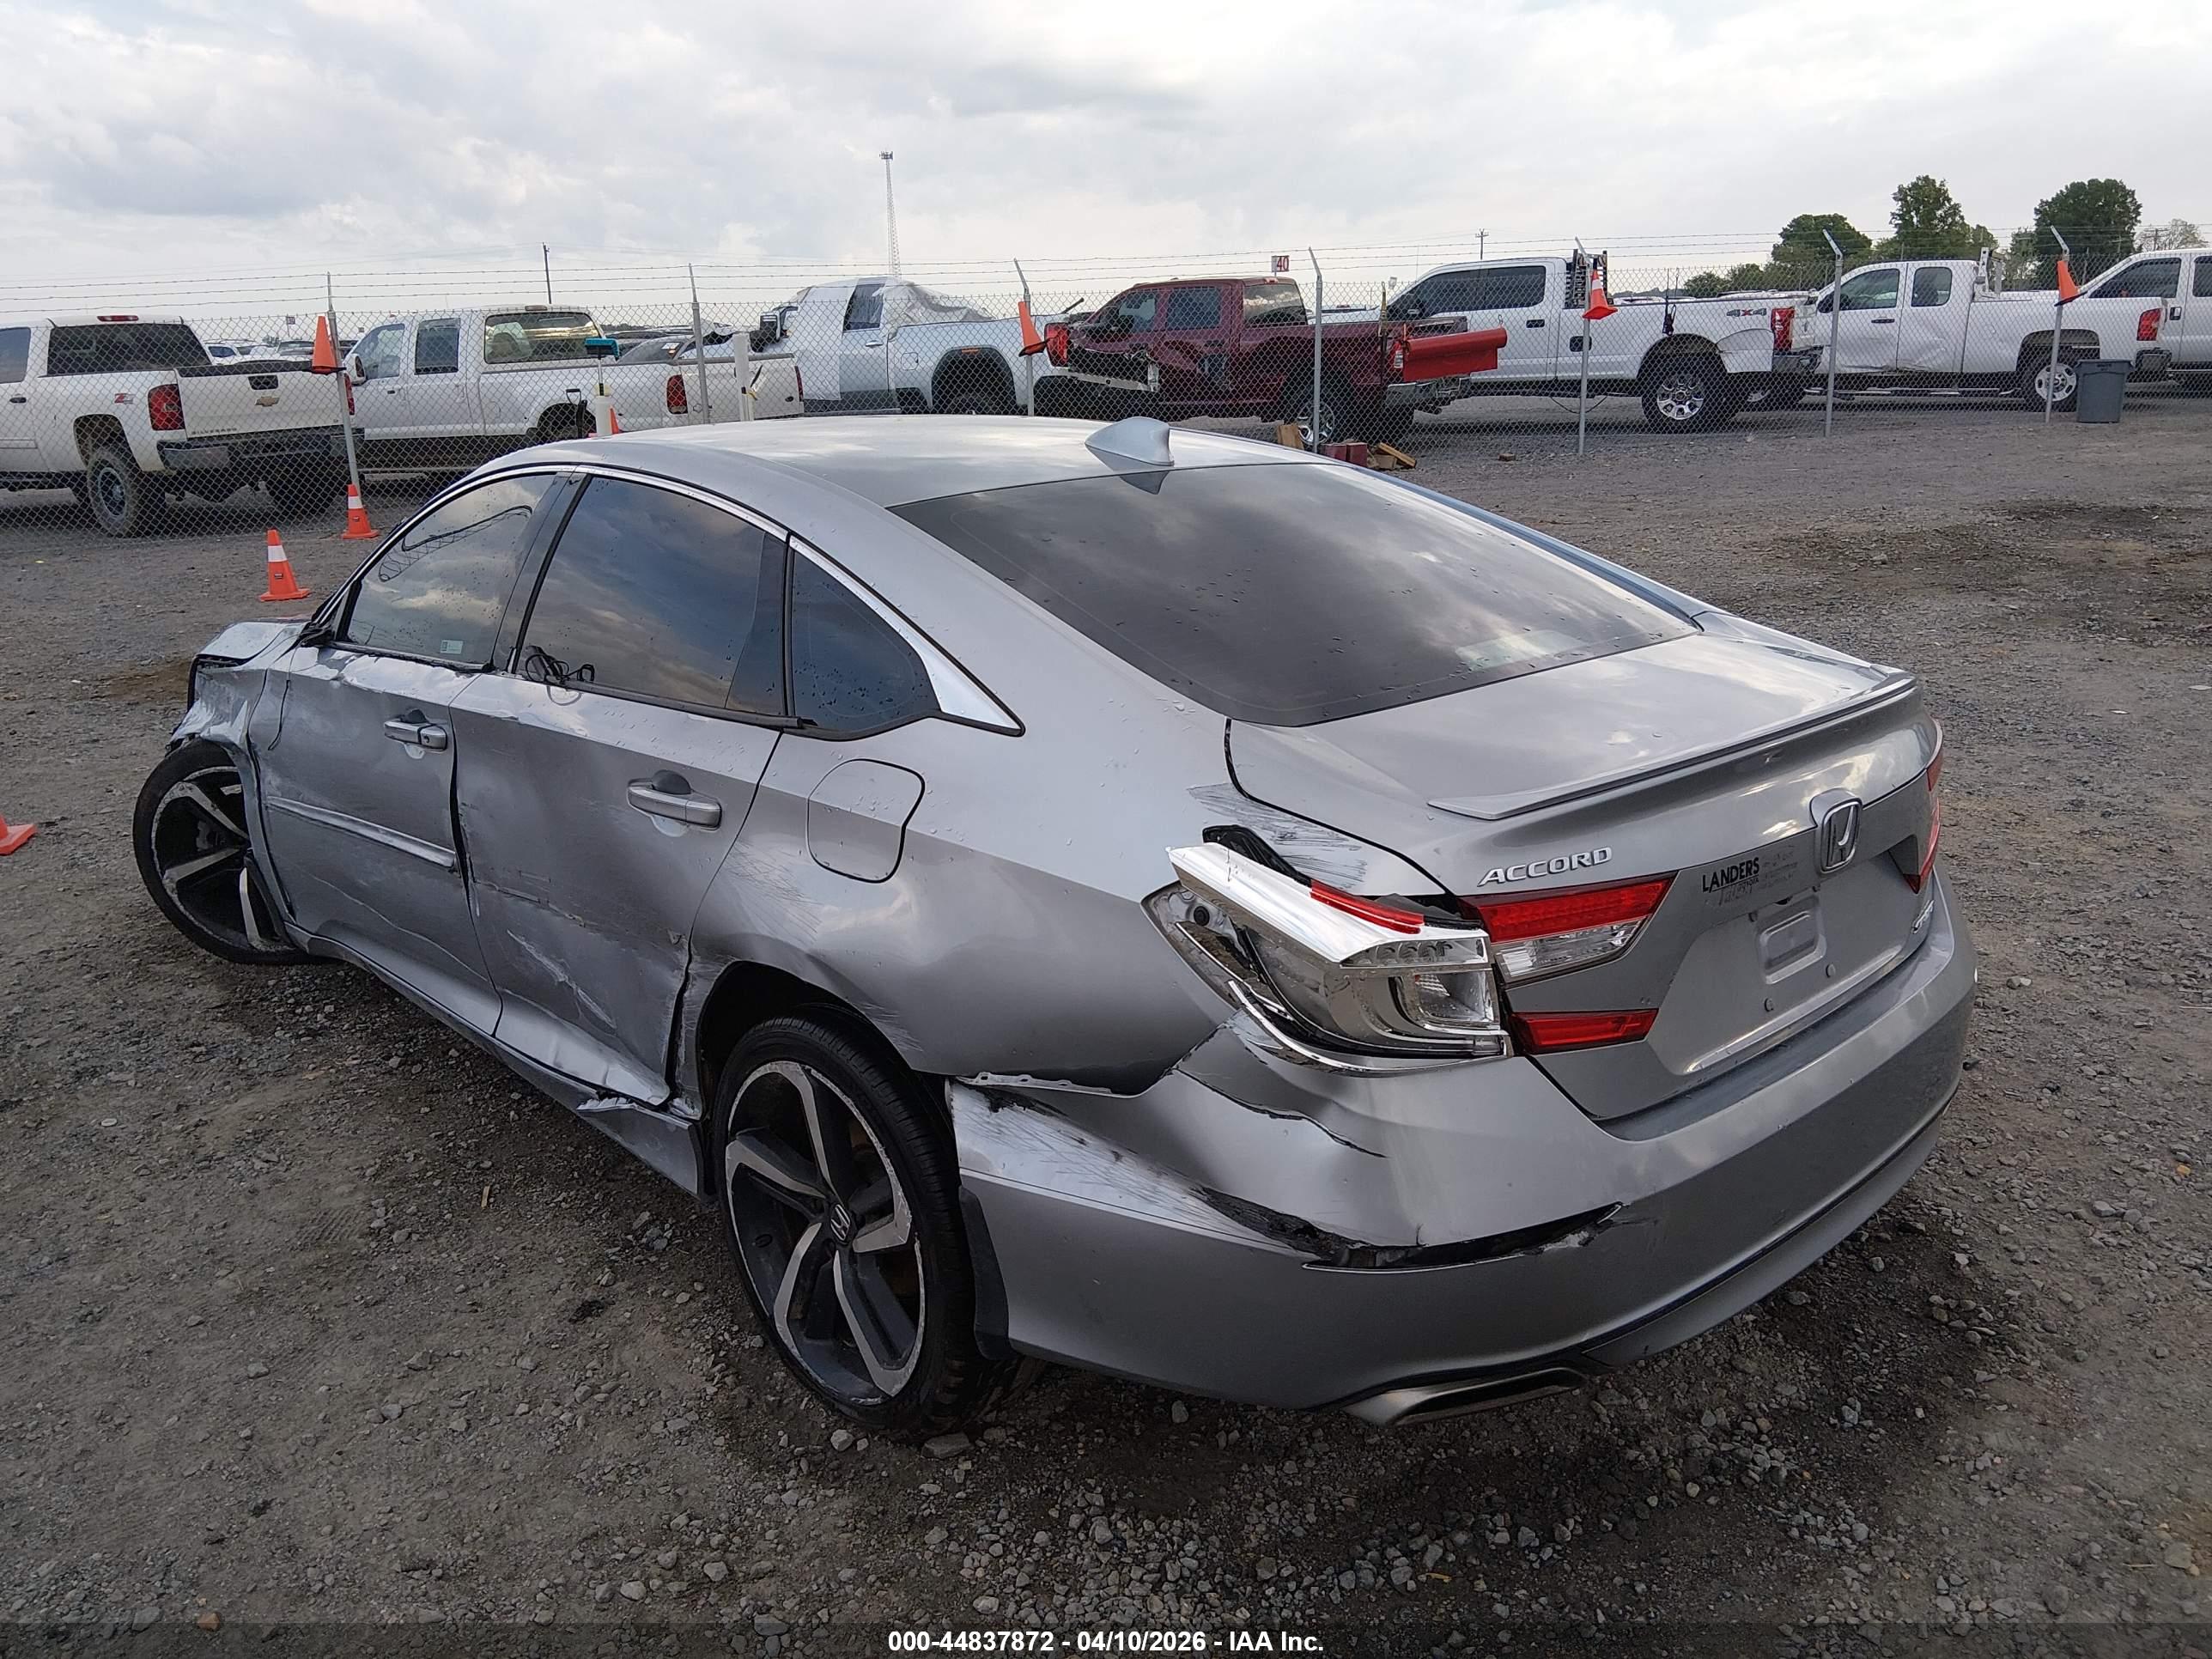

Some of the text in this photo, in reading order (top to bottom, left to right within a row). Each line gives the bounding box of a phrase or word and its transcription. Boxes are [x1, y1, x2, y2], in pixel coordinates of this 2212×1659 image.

[1277, 256, 1289, 271] 40
[1477, 847, 1613, 887] ACCORD
[1702, 857, 1759, 893] LANDERS
